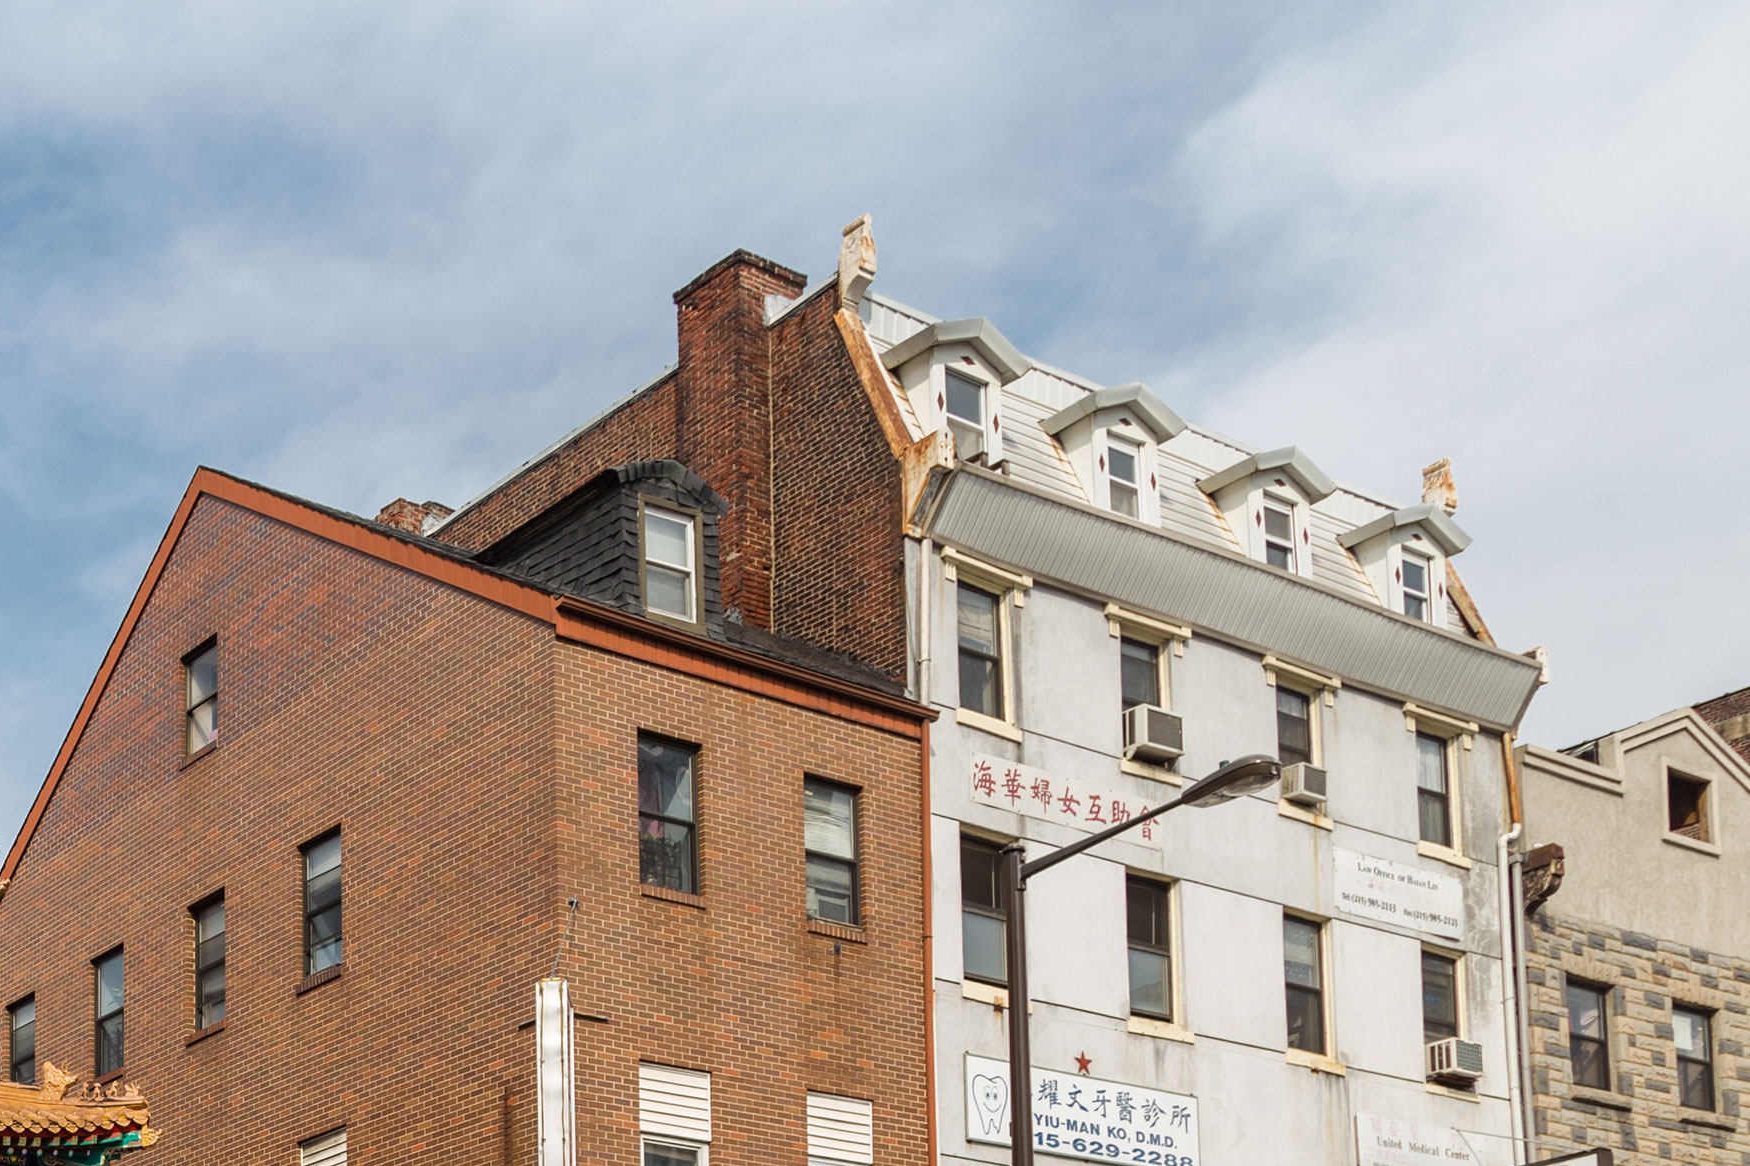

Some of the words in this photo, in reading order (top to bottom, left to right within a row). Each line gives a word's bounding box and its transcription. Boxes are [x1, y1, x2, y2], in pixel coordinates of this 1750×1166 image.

[1038, 1079, 1191, 1135] 耀文牙醫診所
[1034, 1112, 1100, 1136] YIU-MAN
[1107, 1125, 1130, 1143] KO,
[1135, 1133, 1178, 1150] D.M.D.
